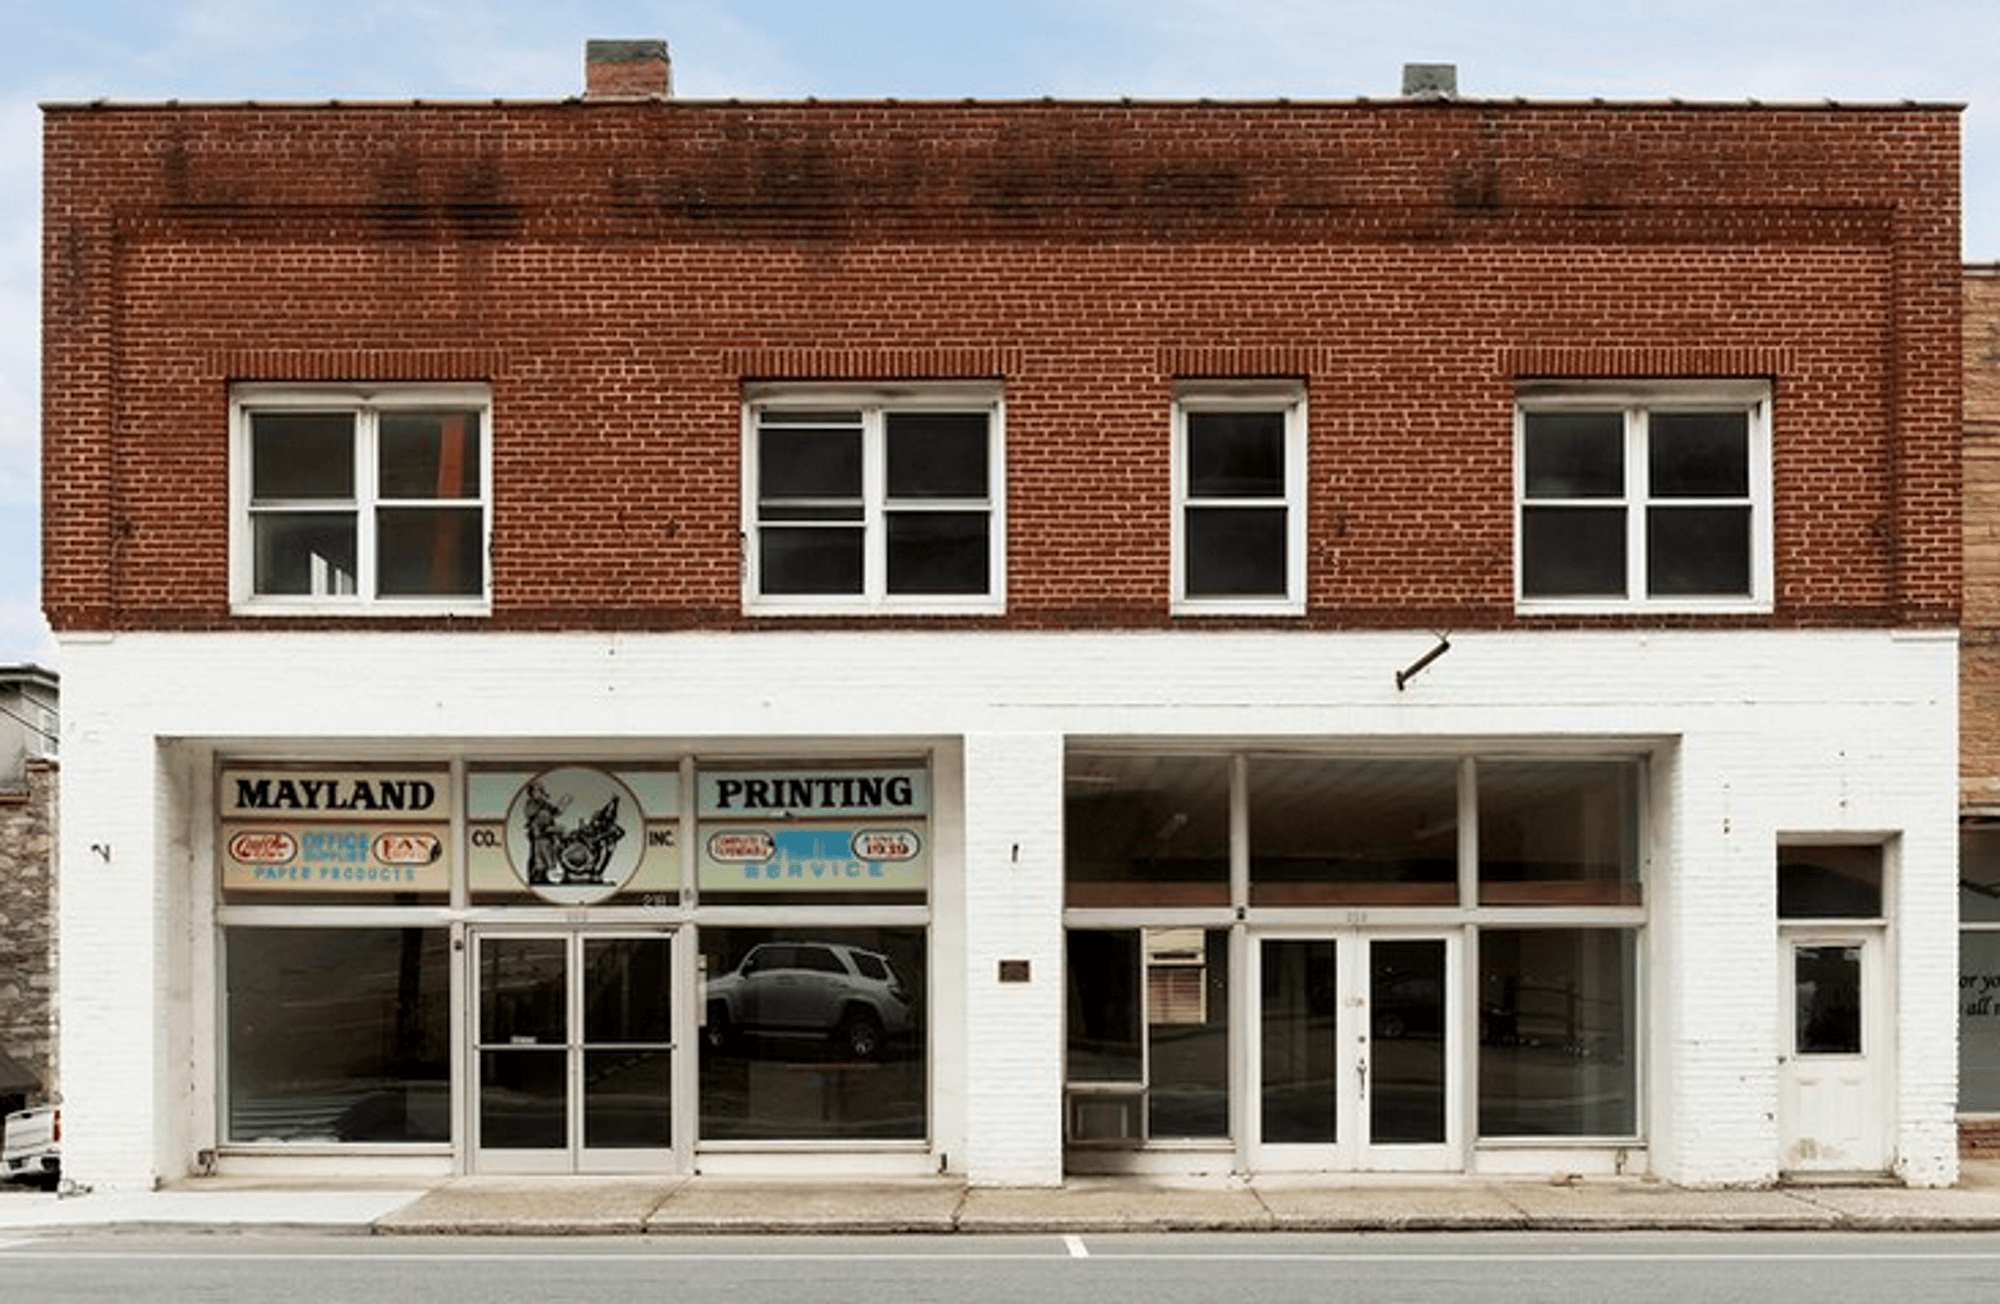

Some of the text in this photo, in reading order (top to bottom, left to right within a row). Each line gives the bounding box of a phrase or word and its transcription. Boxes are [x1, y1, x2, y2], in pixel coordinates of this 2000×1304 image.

[235, 779, 435, 810] MAYLAND
[715, 776, 913, 809] PRINTING
[252, 866, 416, 881] PAPER PRODUCTS
[743, 861, 885, 879] SERVICE
